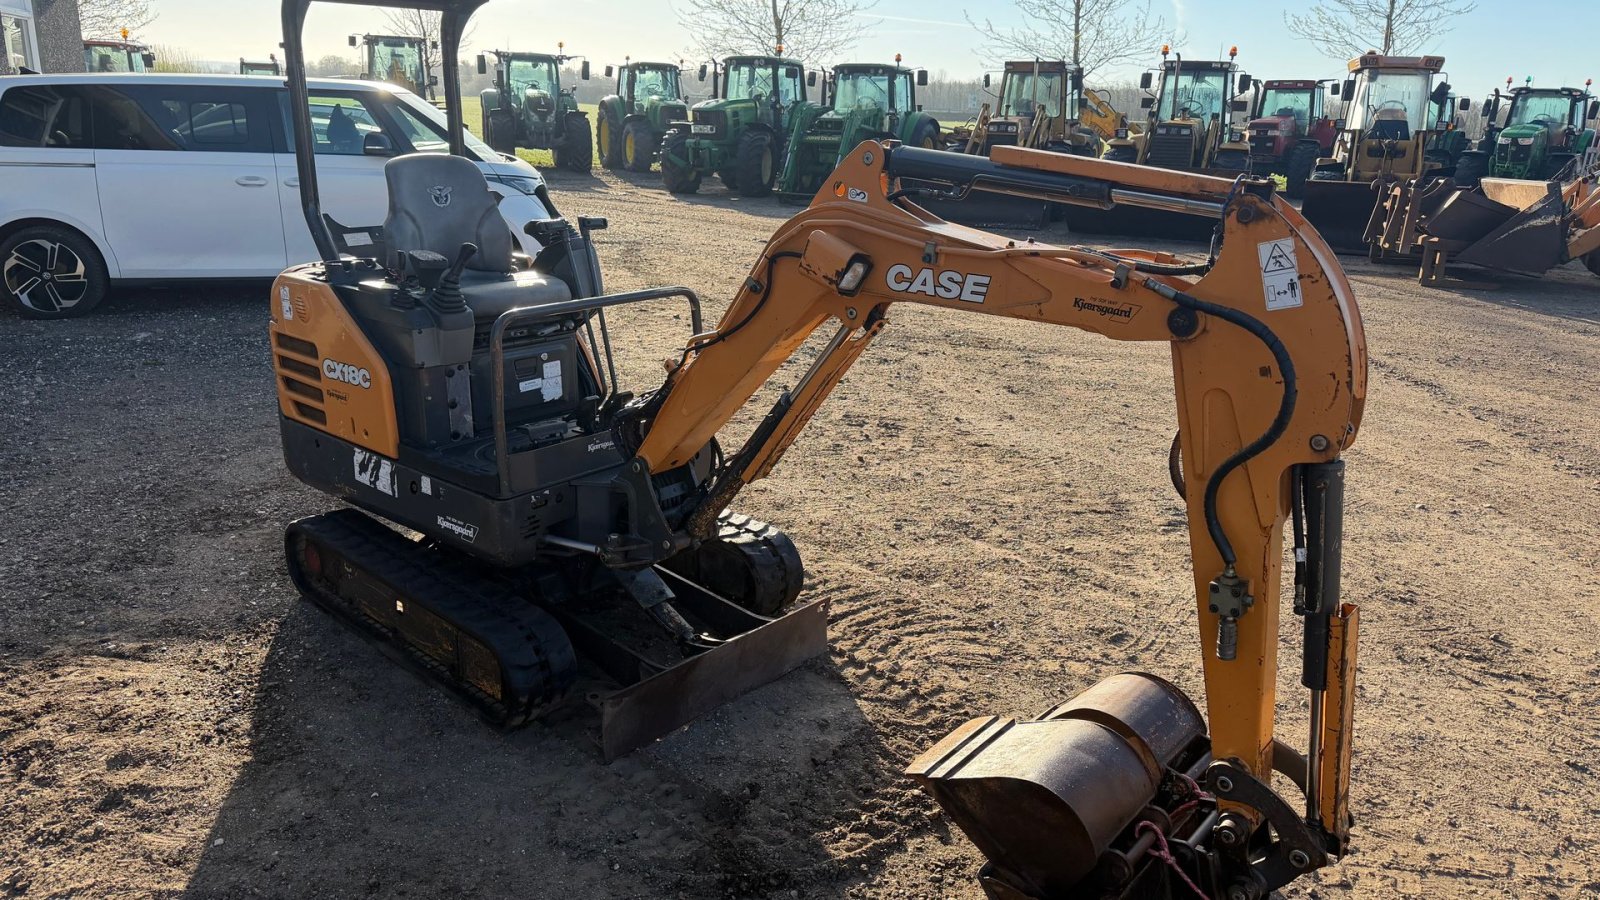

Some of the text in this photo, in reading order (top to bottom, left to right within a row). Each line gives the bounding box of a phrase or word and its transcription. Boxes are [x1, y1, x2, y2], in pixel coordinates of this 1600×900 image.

[886, 263, 992, 304] CASE
[1073, 297, 1133, 319] Kjærsgaard
[322, 358, 372, 390] CX18C
[437, 515, 474, 538] Kjærsgaard
